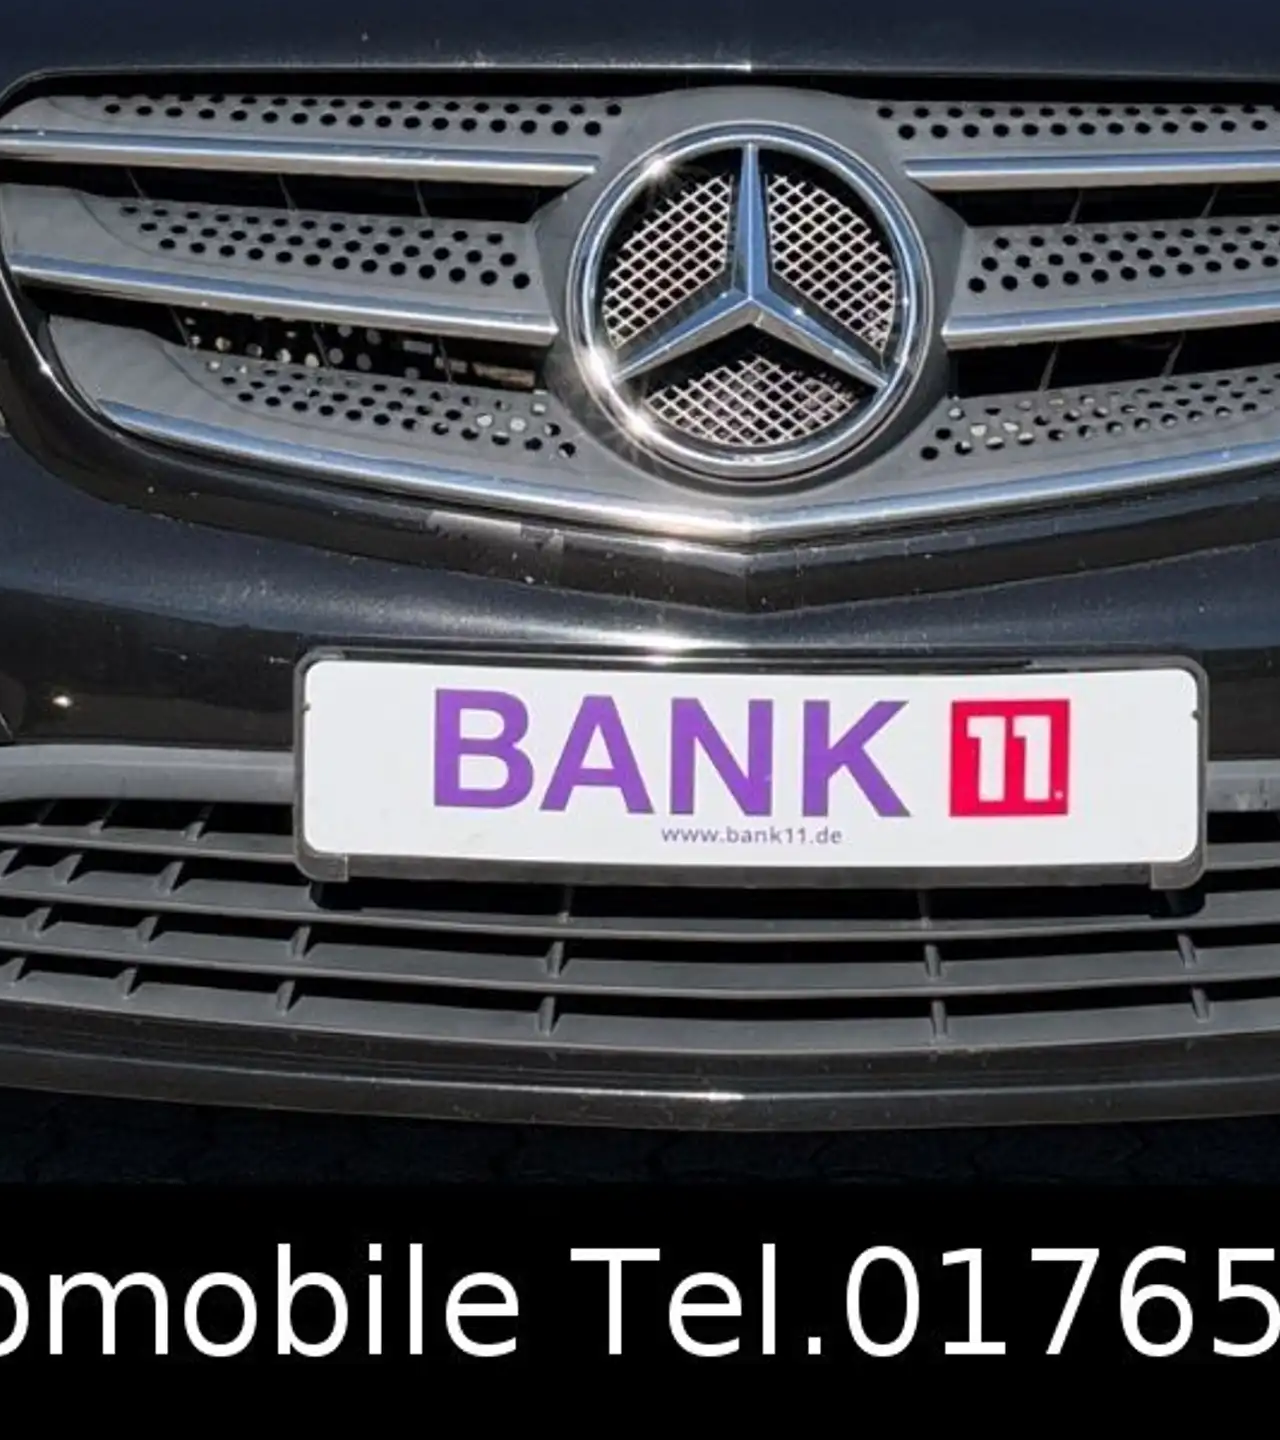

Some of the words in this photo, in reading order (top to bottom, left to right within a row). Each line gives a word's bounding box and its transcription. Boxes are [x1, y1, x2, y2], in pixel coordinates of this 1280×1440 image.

[433, 688, 912, 818] BANK
[966, 714, 1052, 803] 11
[660, 825, 843, 846] www.bank11.de
